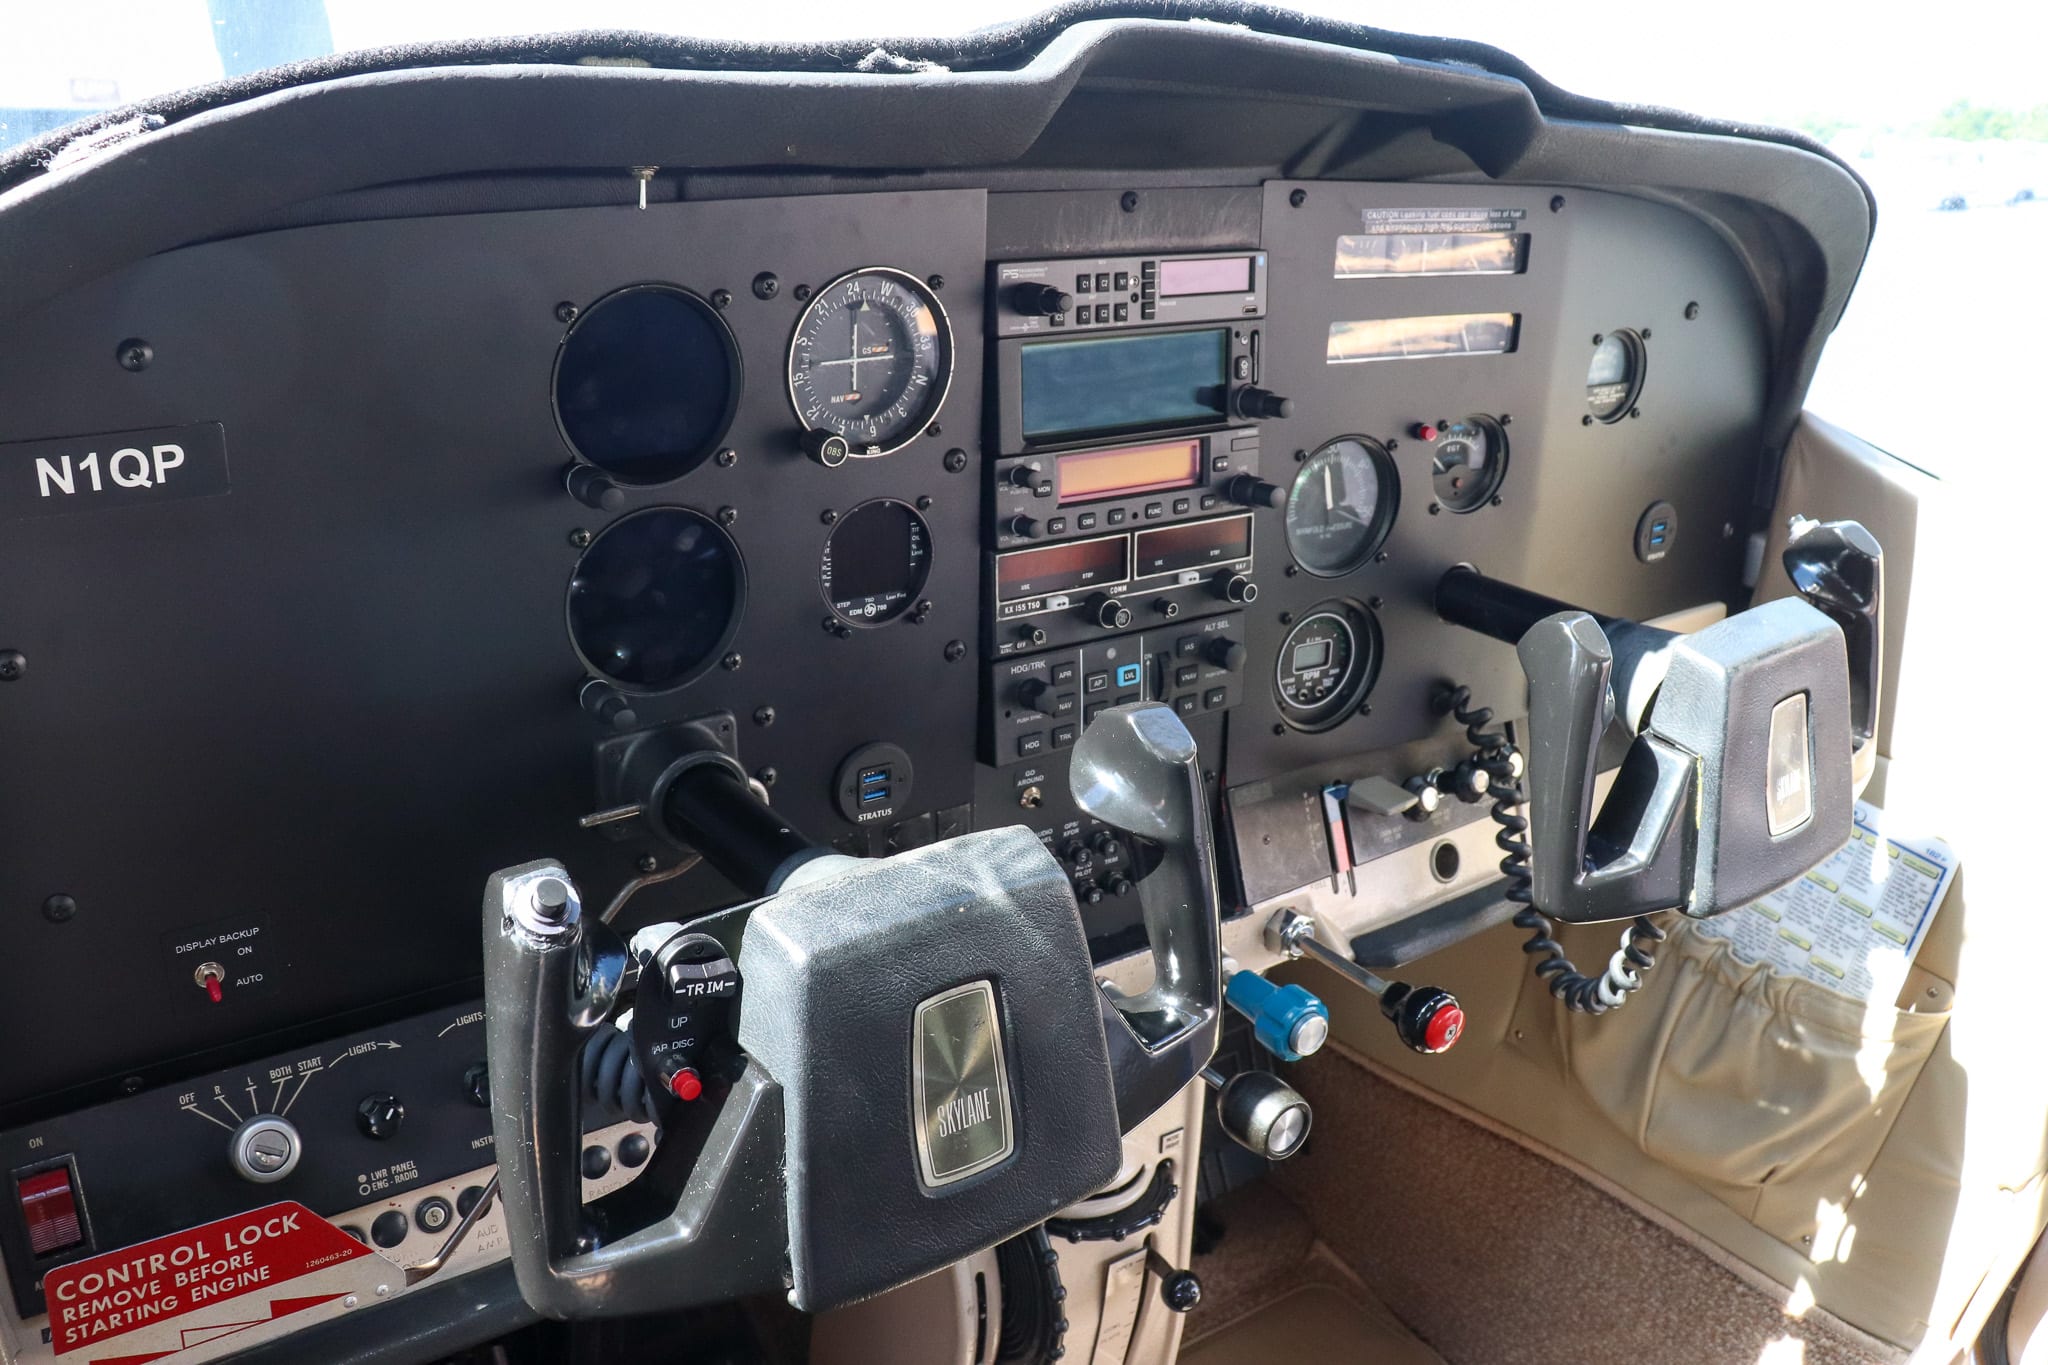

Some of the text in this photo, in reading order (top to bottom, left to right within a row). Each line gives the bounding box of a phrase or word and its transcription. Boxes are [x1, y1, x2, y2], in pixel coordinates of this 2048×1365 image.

[846, 280, 860, 296] 24
[880, 280, 894, 297] W
[814, 298, 829, 316] 21
[906, 301, 919, 318] 30
[796, 336, 808, 346] S
[920, 335, 931, 351] 33
[793, 372, 804, 388] 15
[915, 374, 928, 386] N
[806, 406, 820, 421] 12
[898, 407, 907, 417] 3
[869, 425, 877, 437] 6
[826, 446, 843, 457] OBS
[35, 444, 185, 497] N1QP
[836, 601, 851, 609] STEP
[849, 608, 863, 616] EDM
[1204, 620, 1230, 632] ALT SEL
[1010, 660, 1046, 675] HDG/TRK
[1058, 670, 1072, 679] APR
[1303, 670, 1320, 681] RPM
[1059, 701, 1072, 710] NAV
[1059, 732, 1072, 741] TRK
[1025, 740, 1040, 750] HDG
[1017, 775, 1045, 787] AROUND
[858, 808, 893, 822] STRATUS
[175, 927, 260, 954] DISPLAY BACKUP
[237, 946, 253, 956] ON
[236, 973, 263, 987] AUTO
[686, 980, 724, 996] TRIM
[456, 1011, 484, 1027] LIGHTS
[671, 1016, 688, 1029] UP
[348, 1041, 378, 1057] LIGHTS
[672, 1038, 695, 1050] DISC
[297, 1056, 322, 1071] START
[269, 1065, 292, 1079] BOTH
[247, 1077, 254, 1086] L
[214, 1085, 221, 1095] R
[178, 1092, 195, 1106] OFF
[936, 1088, 992, 1138] SKYLANE
[28, 1137, 43, 1149] ON
[370, 1160, 416, 1181] LWR PANEL
[430, 1207, 439, 1223] 5
[56, 1212, 301, 1301] CONTROL LOCK
[305, 1248, 353, 1269] 1260463-20
[62, 1251, 254, 1324] REMOVE BEFORE
[66, 1265, 270, 1345] STARTING ENGINE
